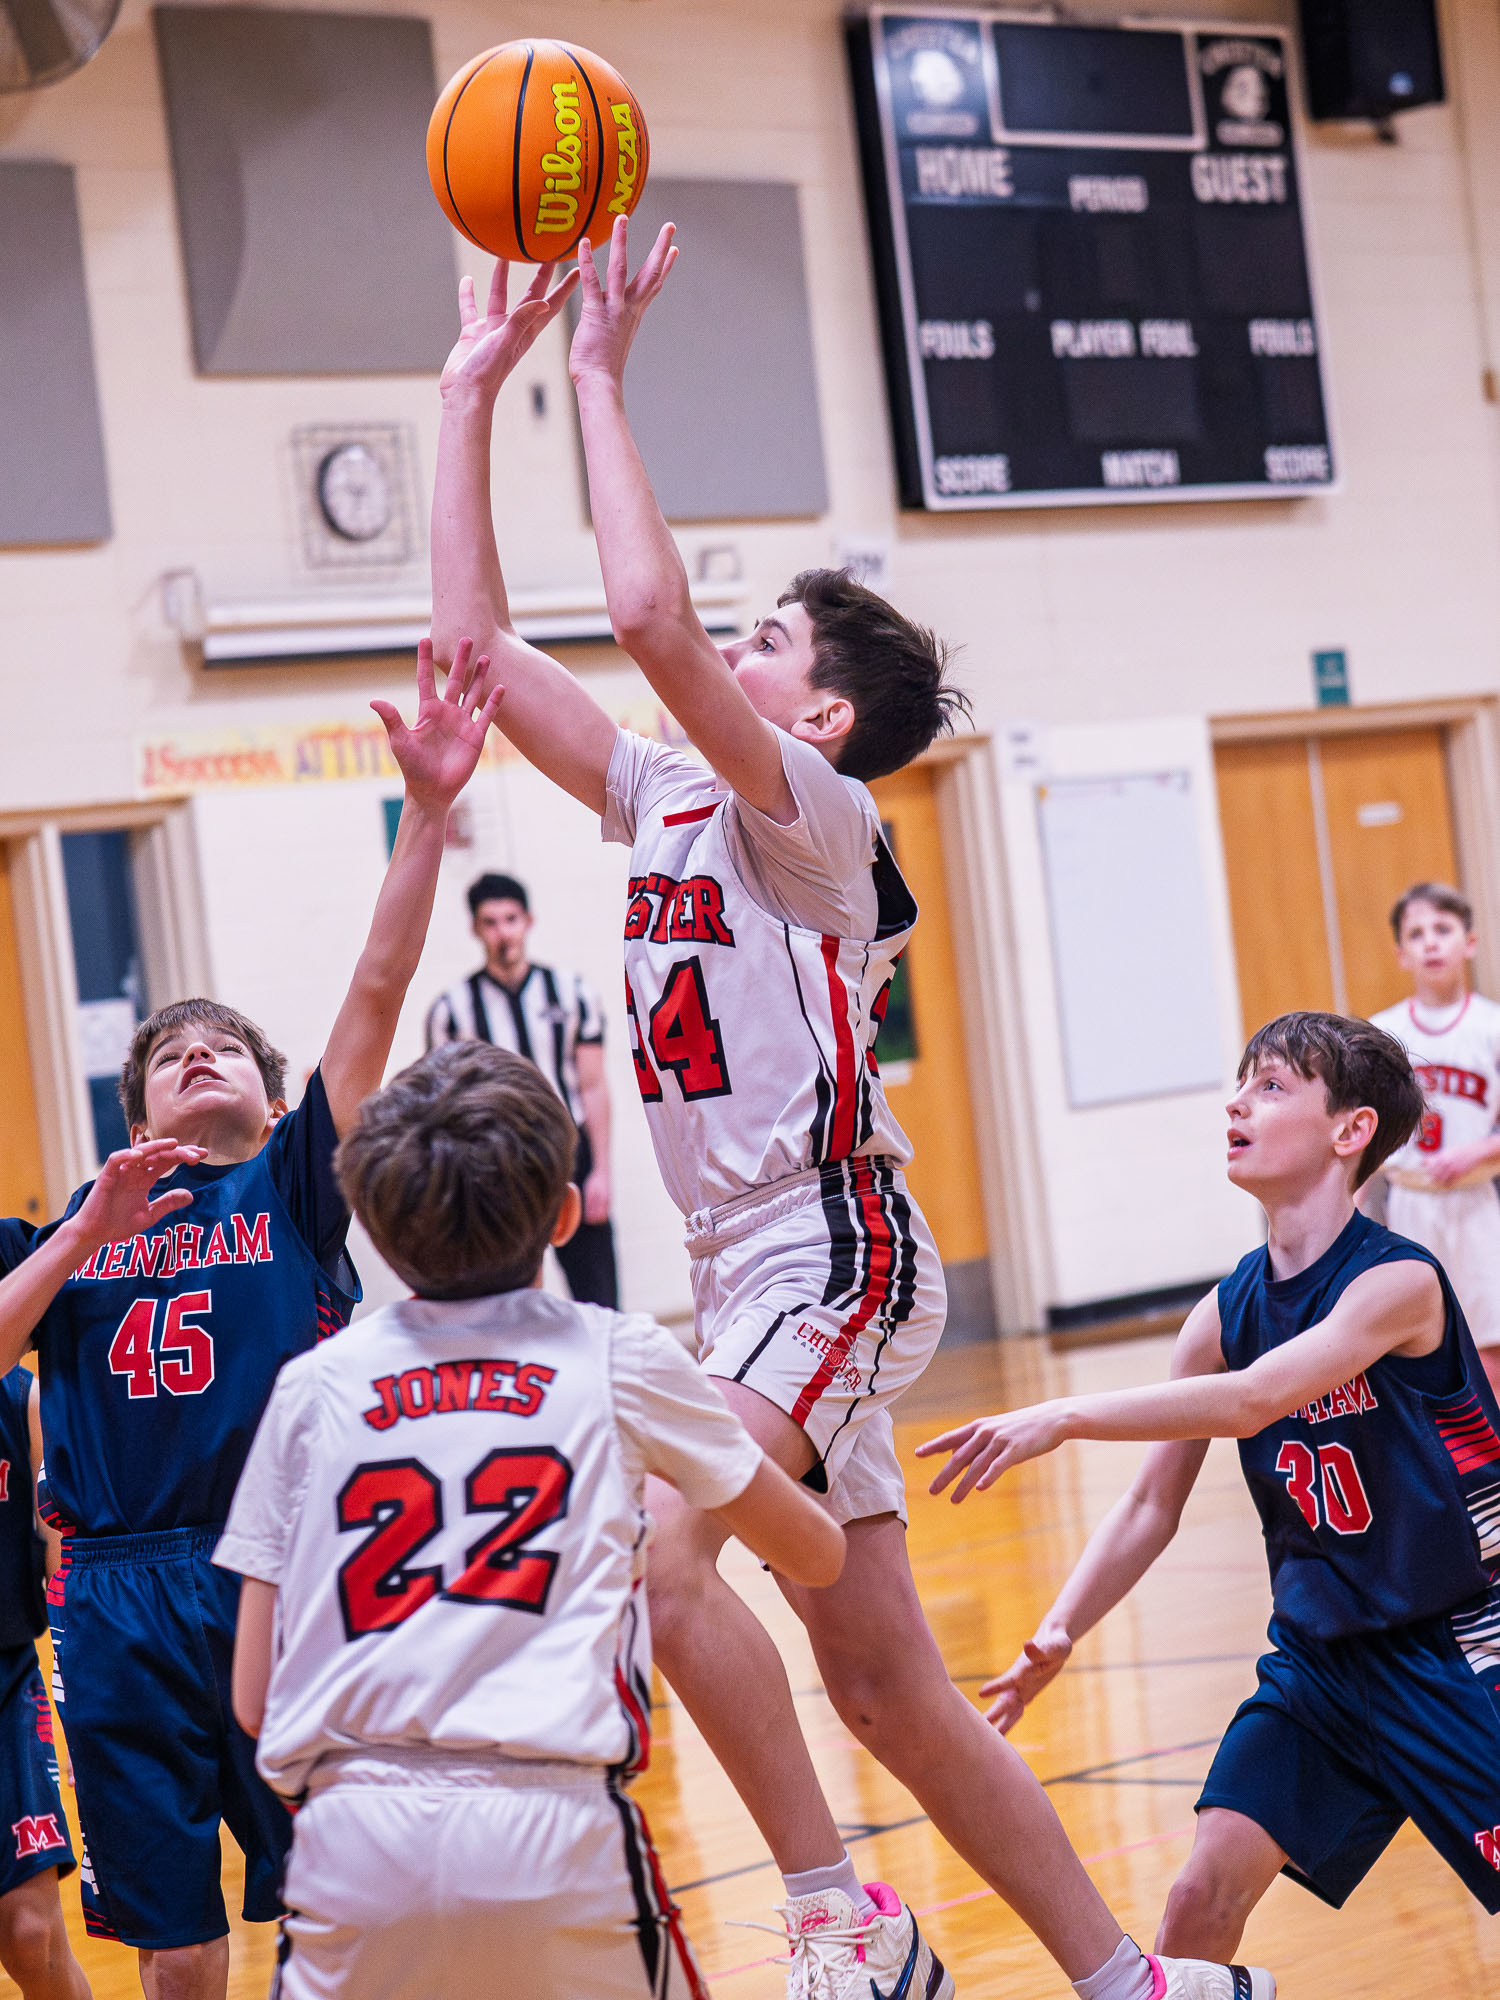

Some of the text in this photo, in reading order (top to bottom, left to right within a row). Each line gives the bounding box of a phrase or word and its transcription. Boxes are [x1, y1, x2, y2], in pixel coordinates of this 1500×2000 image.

[534, 81, 582, 235] Wilson
[607, 103, 637, 214] NCAA
[916, 149, 1013, 196] HOME
[1191, 154, 1286, 202] GUEST
[1068, 174, 1148, 212] PERIOD
[920, 320, 995, 360] FOULS
[1050, 319, 1198, 359] PLAYER FOUL
[1248, 319, 1315, 358] FOULS
[936, 455, 1010, 494] SCORE
[1102, 450, 1180, 487] MATCH
[1264, 445, 1328, 483] SCORE
[108, 1289, 214, 1399] 45
[361, 1359, 557, 1431] JONES
[1275, 1441, 1373, 1535] 30
[335, 1445, 575, 1643] 22
[11, 1812, 67, 1860] M
